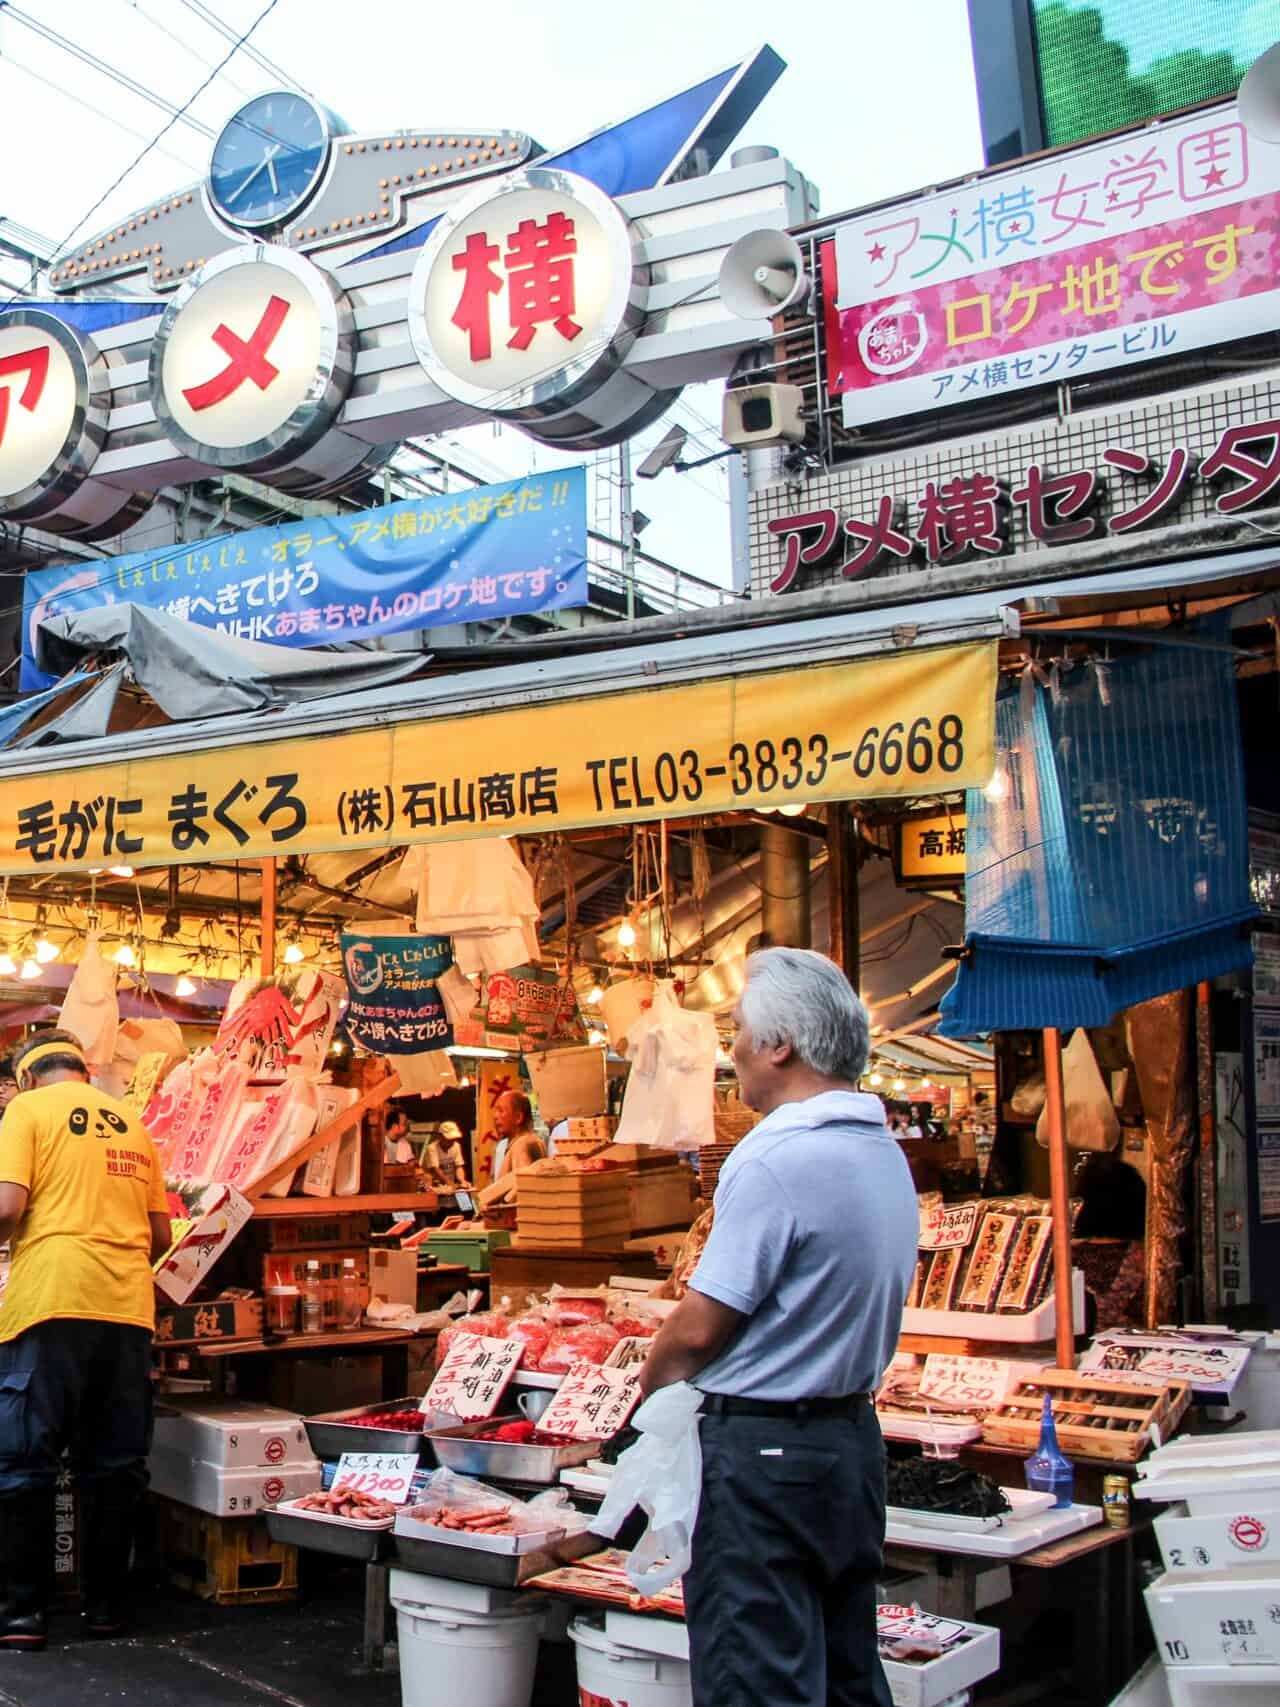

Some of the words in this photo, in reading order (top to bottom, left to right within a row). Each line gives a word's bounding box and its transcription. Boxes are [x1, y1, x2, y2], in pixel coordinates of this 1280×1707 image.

[945, 223, 1257, 348] ロケ地です
[931, 322, 1178, 399] アメ横センタービル
[14, 795, 145, 862] 毛がに
[167, 773, 308, 850] まぐろ
[586, 713, 965, 812] TEL03-3833-6668
[346, 1017, 449, 1042] アメ横へきてけろ
